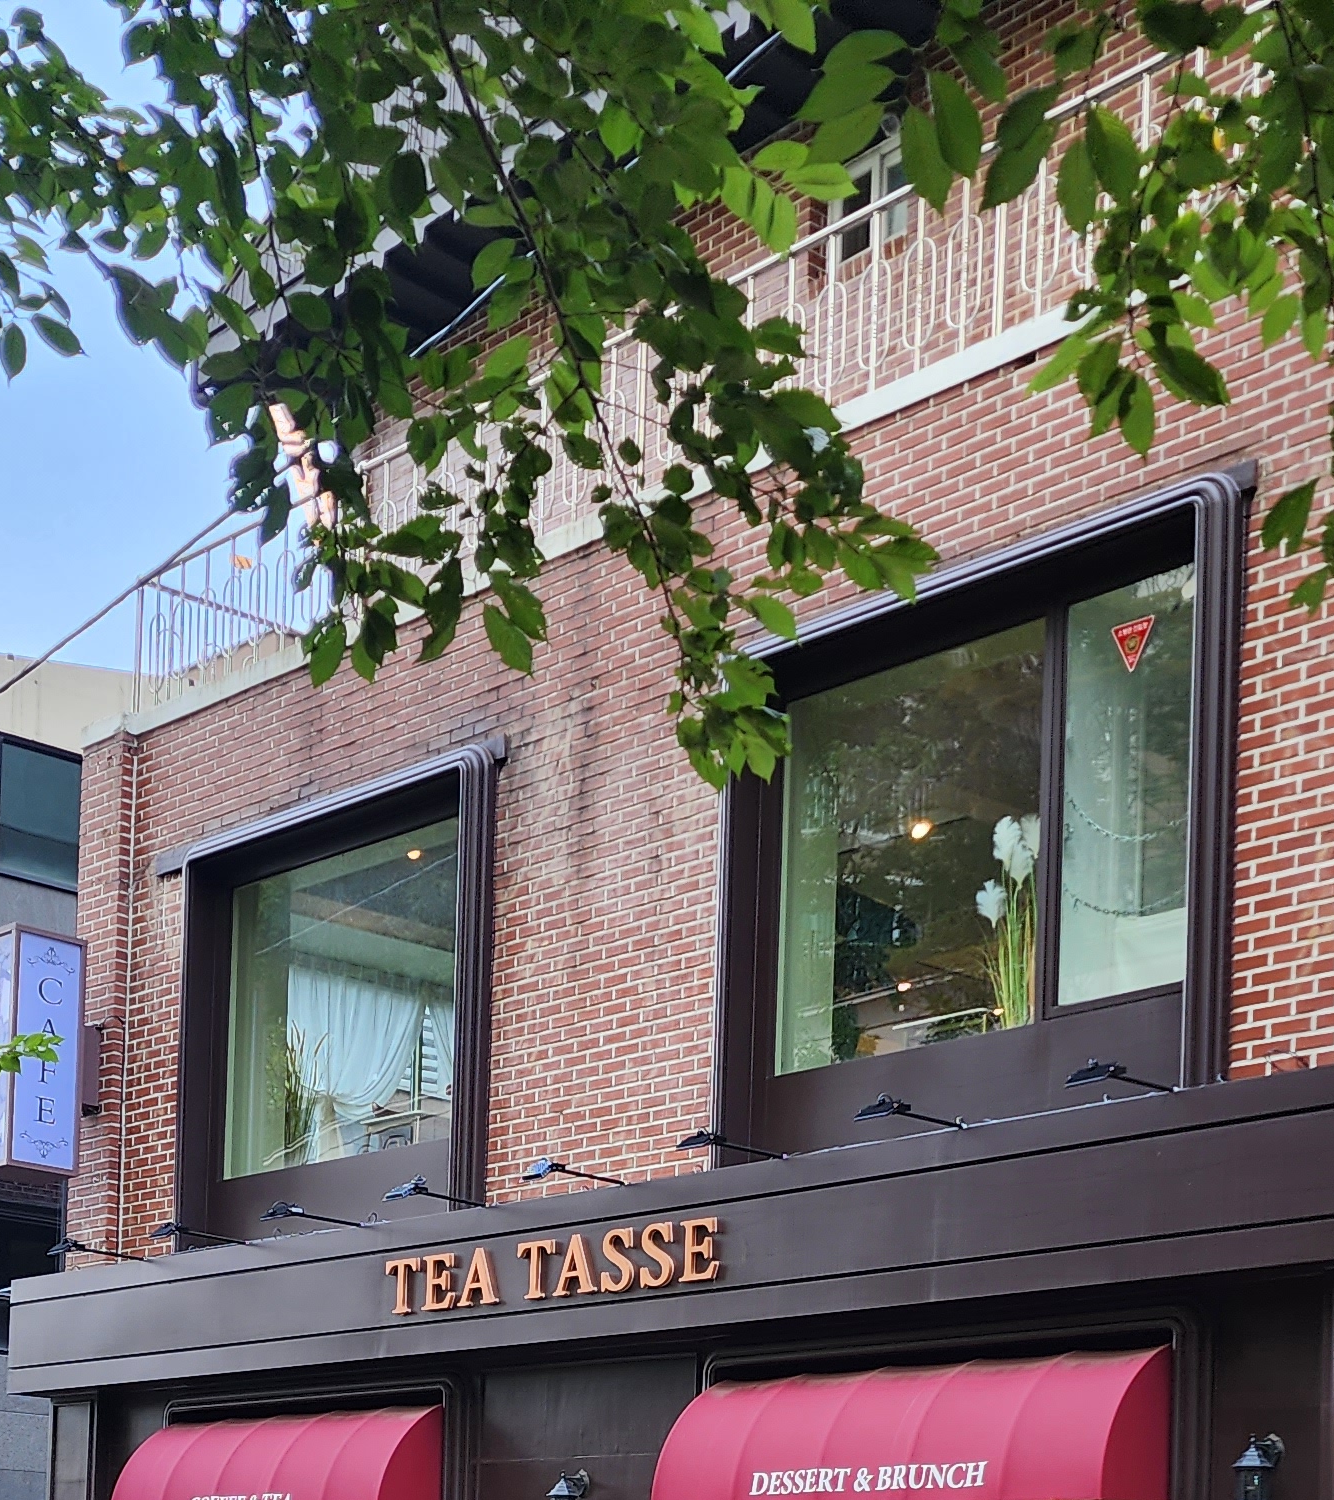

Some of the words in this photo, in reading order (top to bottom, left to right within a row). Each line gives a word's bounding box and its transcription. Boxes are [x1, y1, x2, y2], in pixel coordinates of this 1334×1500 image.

[385, 1246, 501, 1316] TEA
[517, 1216, 721, 1300] TASSE
[749, 1467, 852, 1496] DESSERT
[853, 1467, 874, 1492] &
[875, 1460, 989, 1491] BRUNCH
